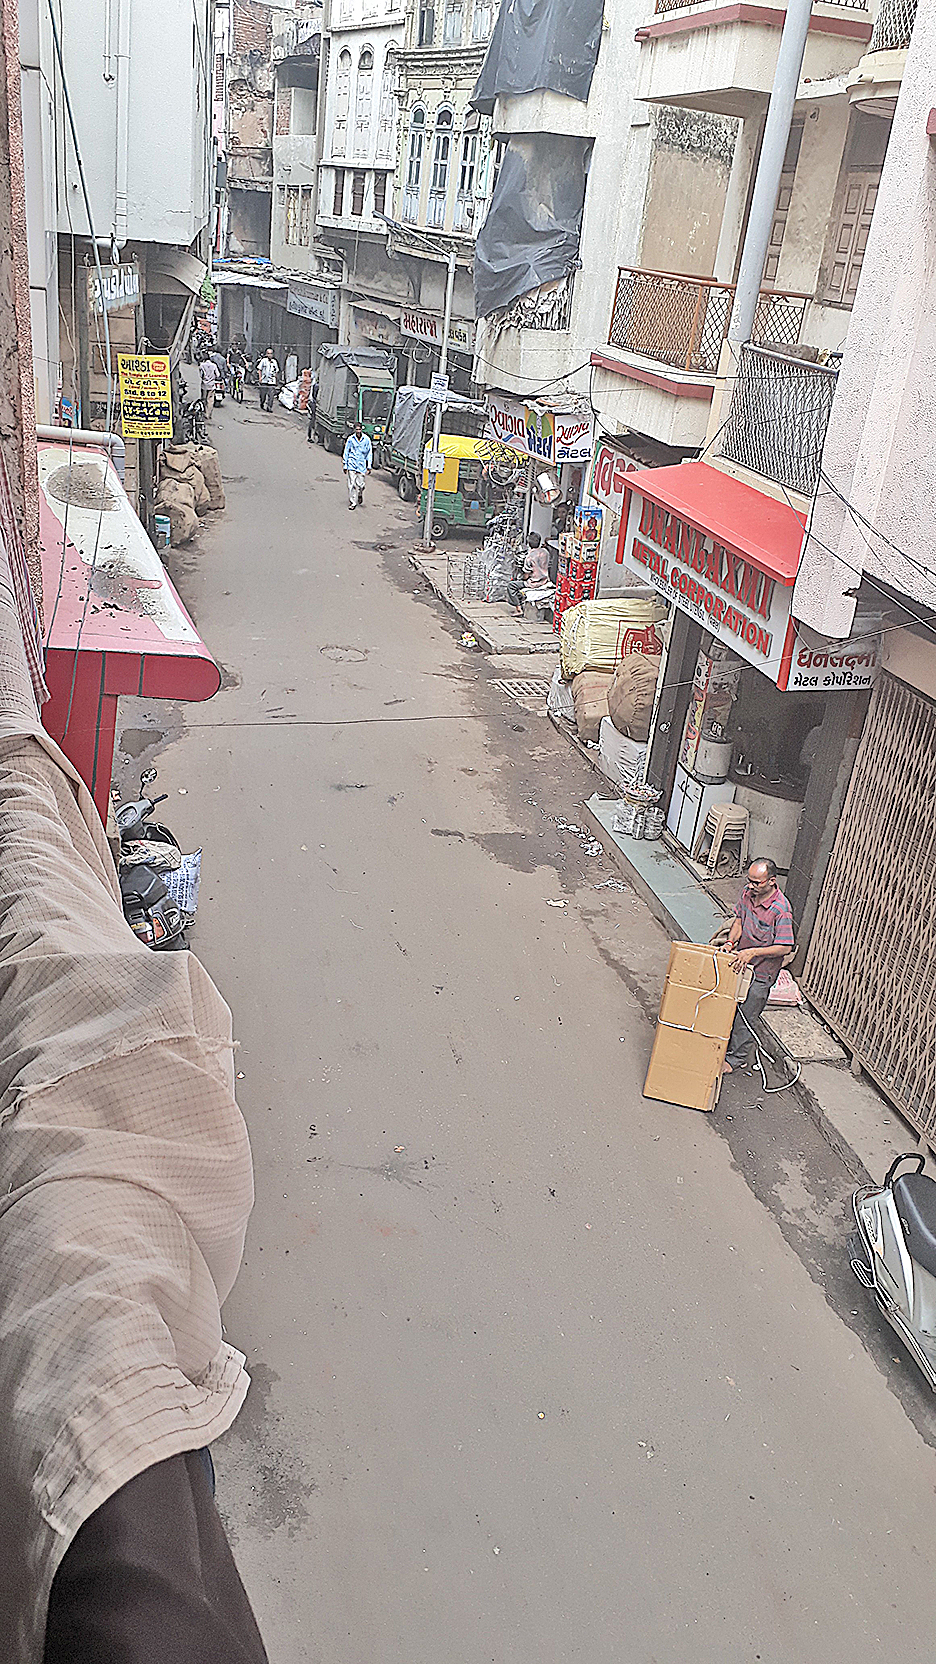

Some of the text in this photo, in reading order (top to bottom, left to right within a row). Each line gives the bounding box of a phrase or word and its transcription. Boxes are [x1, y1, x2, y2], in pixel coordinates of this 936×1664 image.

[632, 538, 773, 658] METAL CORPORATION
[637, 496, 772, 621] DHANLAXMI
[794, 672, 818, 686] મેટલ
